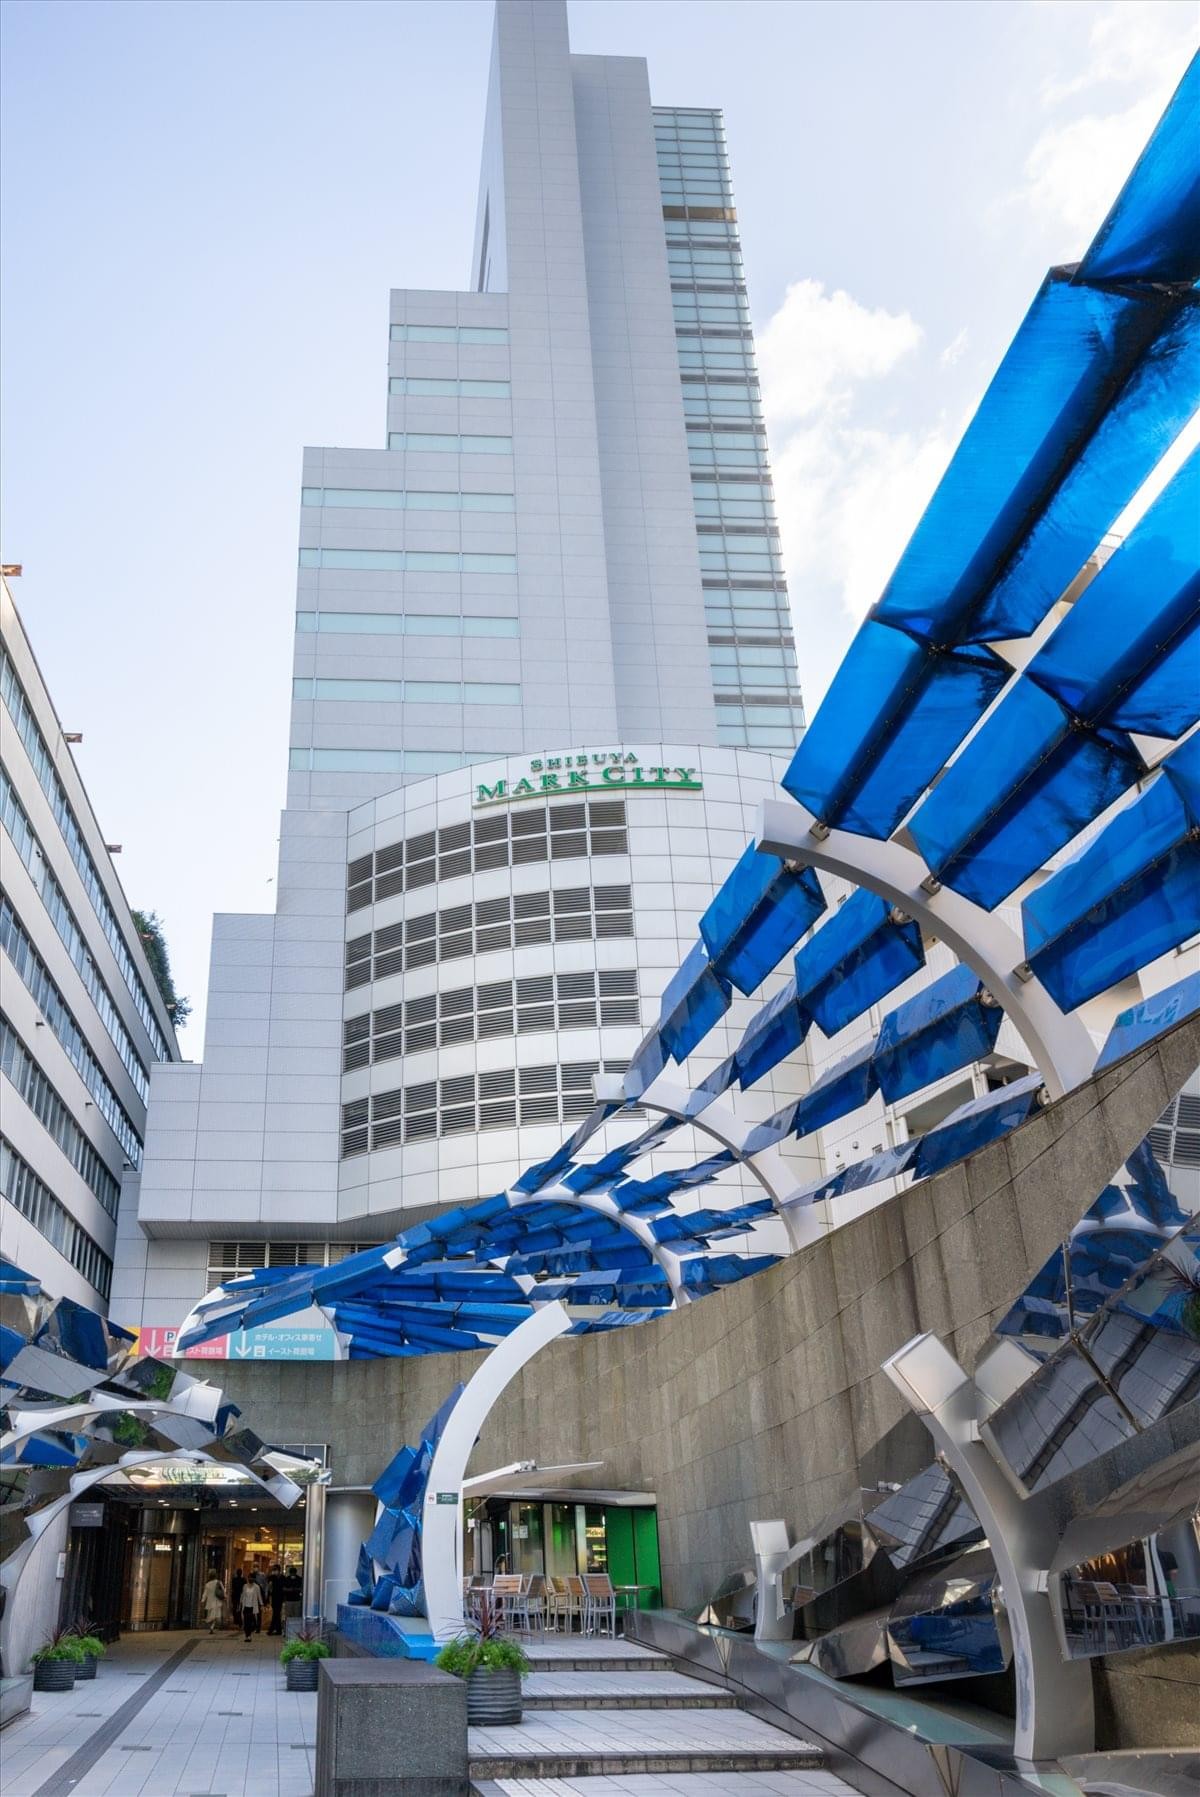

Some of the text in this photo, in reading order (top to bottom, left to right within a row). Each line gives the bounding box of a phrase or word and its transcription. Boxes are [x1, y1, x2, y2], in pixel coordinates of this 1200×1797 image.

[530, 752, 638, 772] SHIBUYA
[477, 766, 696, 801] MARK CITY
